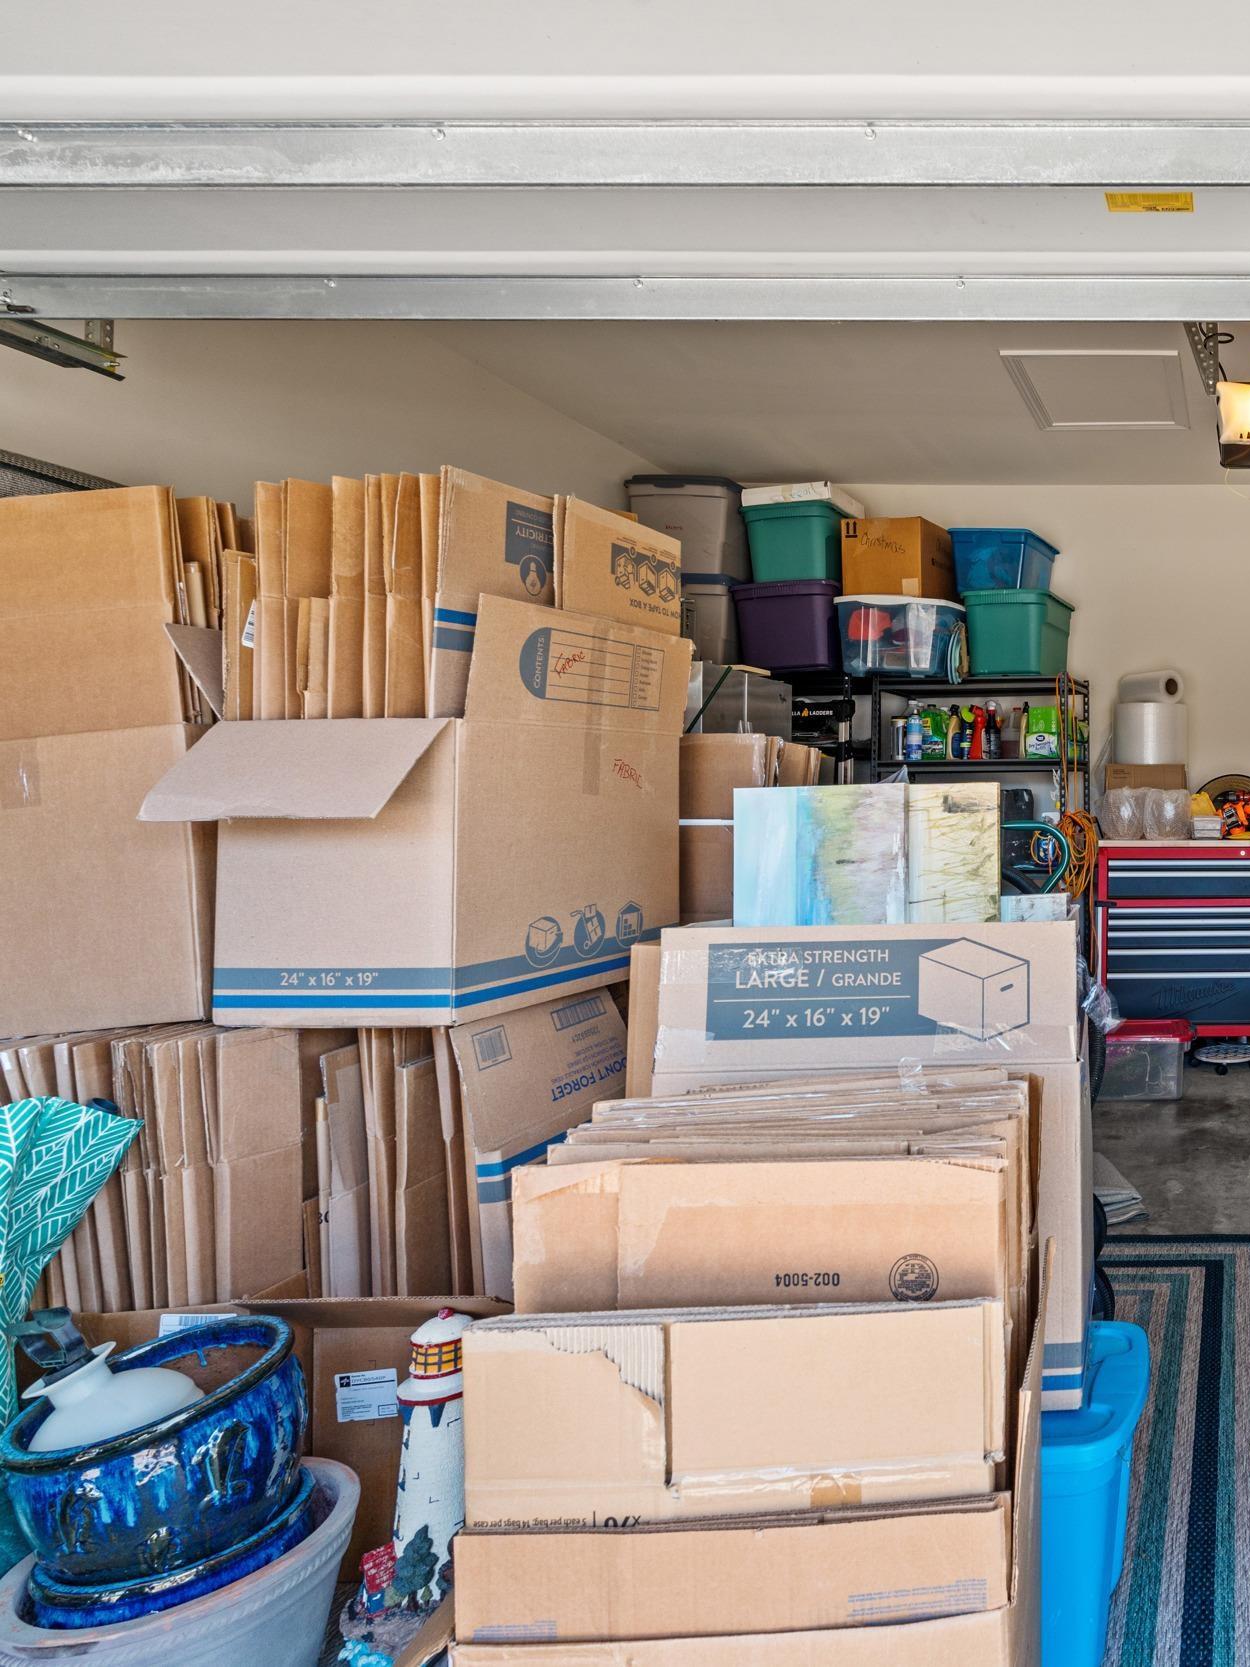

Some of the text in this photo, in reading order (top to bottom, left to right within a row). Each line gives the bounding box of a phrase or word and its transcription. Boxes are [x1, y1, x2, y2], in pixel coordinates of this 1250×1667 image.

[629, 598, 642, 609] BOX
[642, 602, 648, 610] A
[648, 604, 662, 615] TAPE
[661, 607, 669, 617] TO
[748, 949, 889, 964] EXTRA STRENGTH
[280, 972, 379, 986] 24" x 16" x 19"
[735, 969, 902, 989] LARGE / GRANDE
[742, 1006, 891, 1029] 24" x 16" x 19"
[551, 1072, 596, 1102] FORGET
[775, 1272, 840, 1287] 002-5004
[473, 1520, 489, 1529] case
[490, 1518, 502, 1528] per
[503, 1517, 520, 1529] bags
[521, 1519, 530, 1529] 14
[550, 1516, 562, 1527] per
[563, 1518, 581, 1528] each
